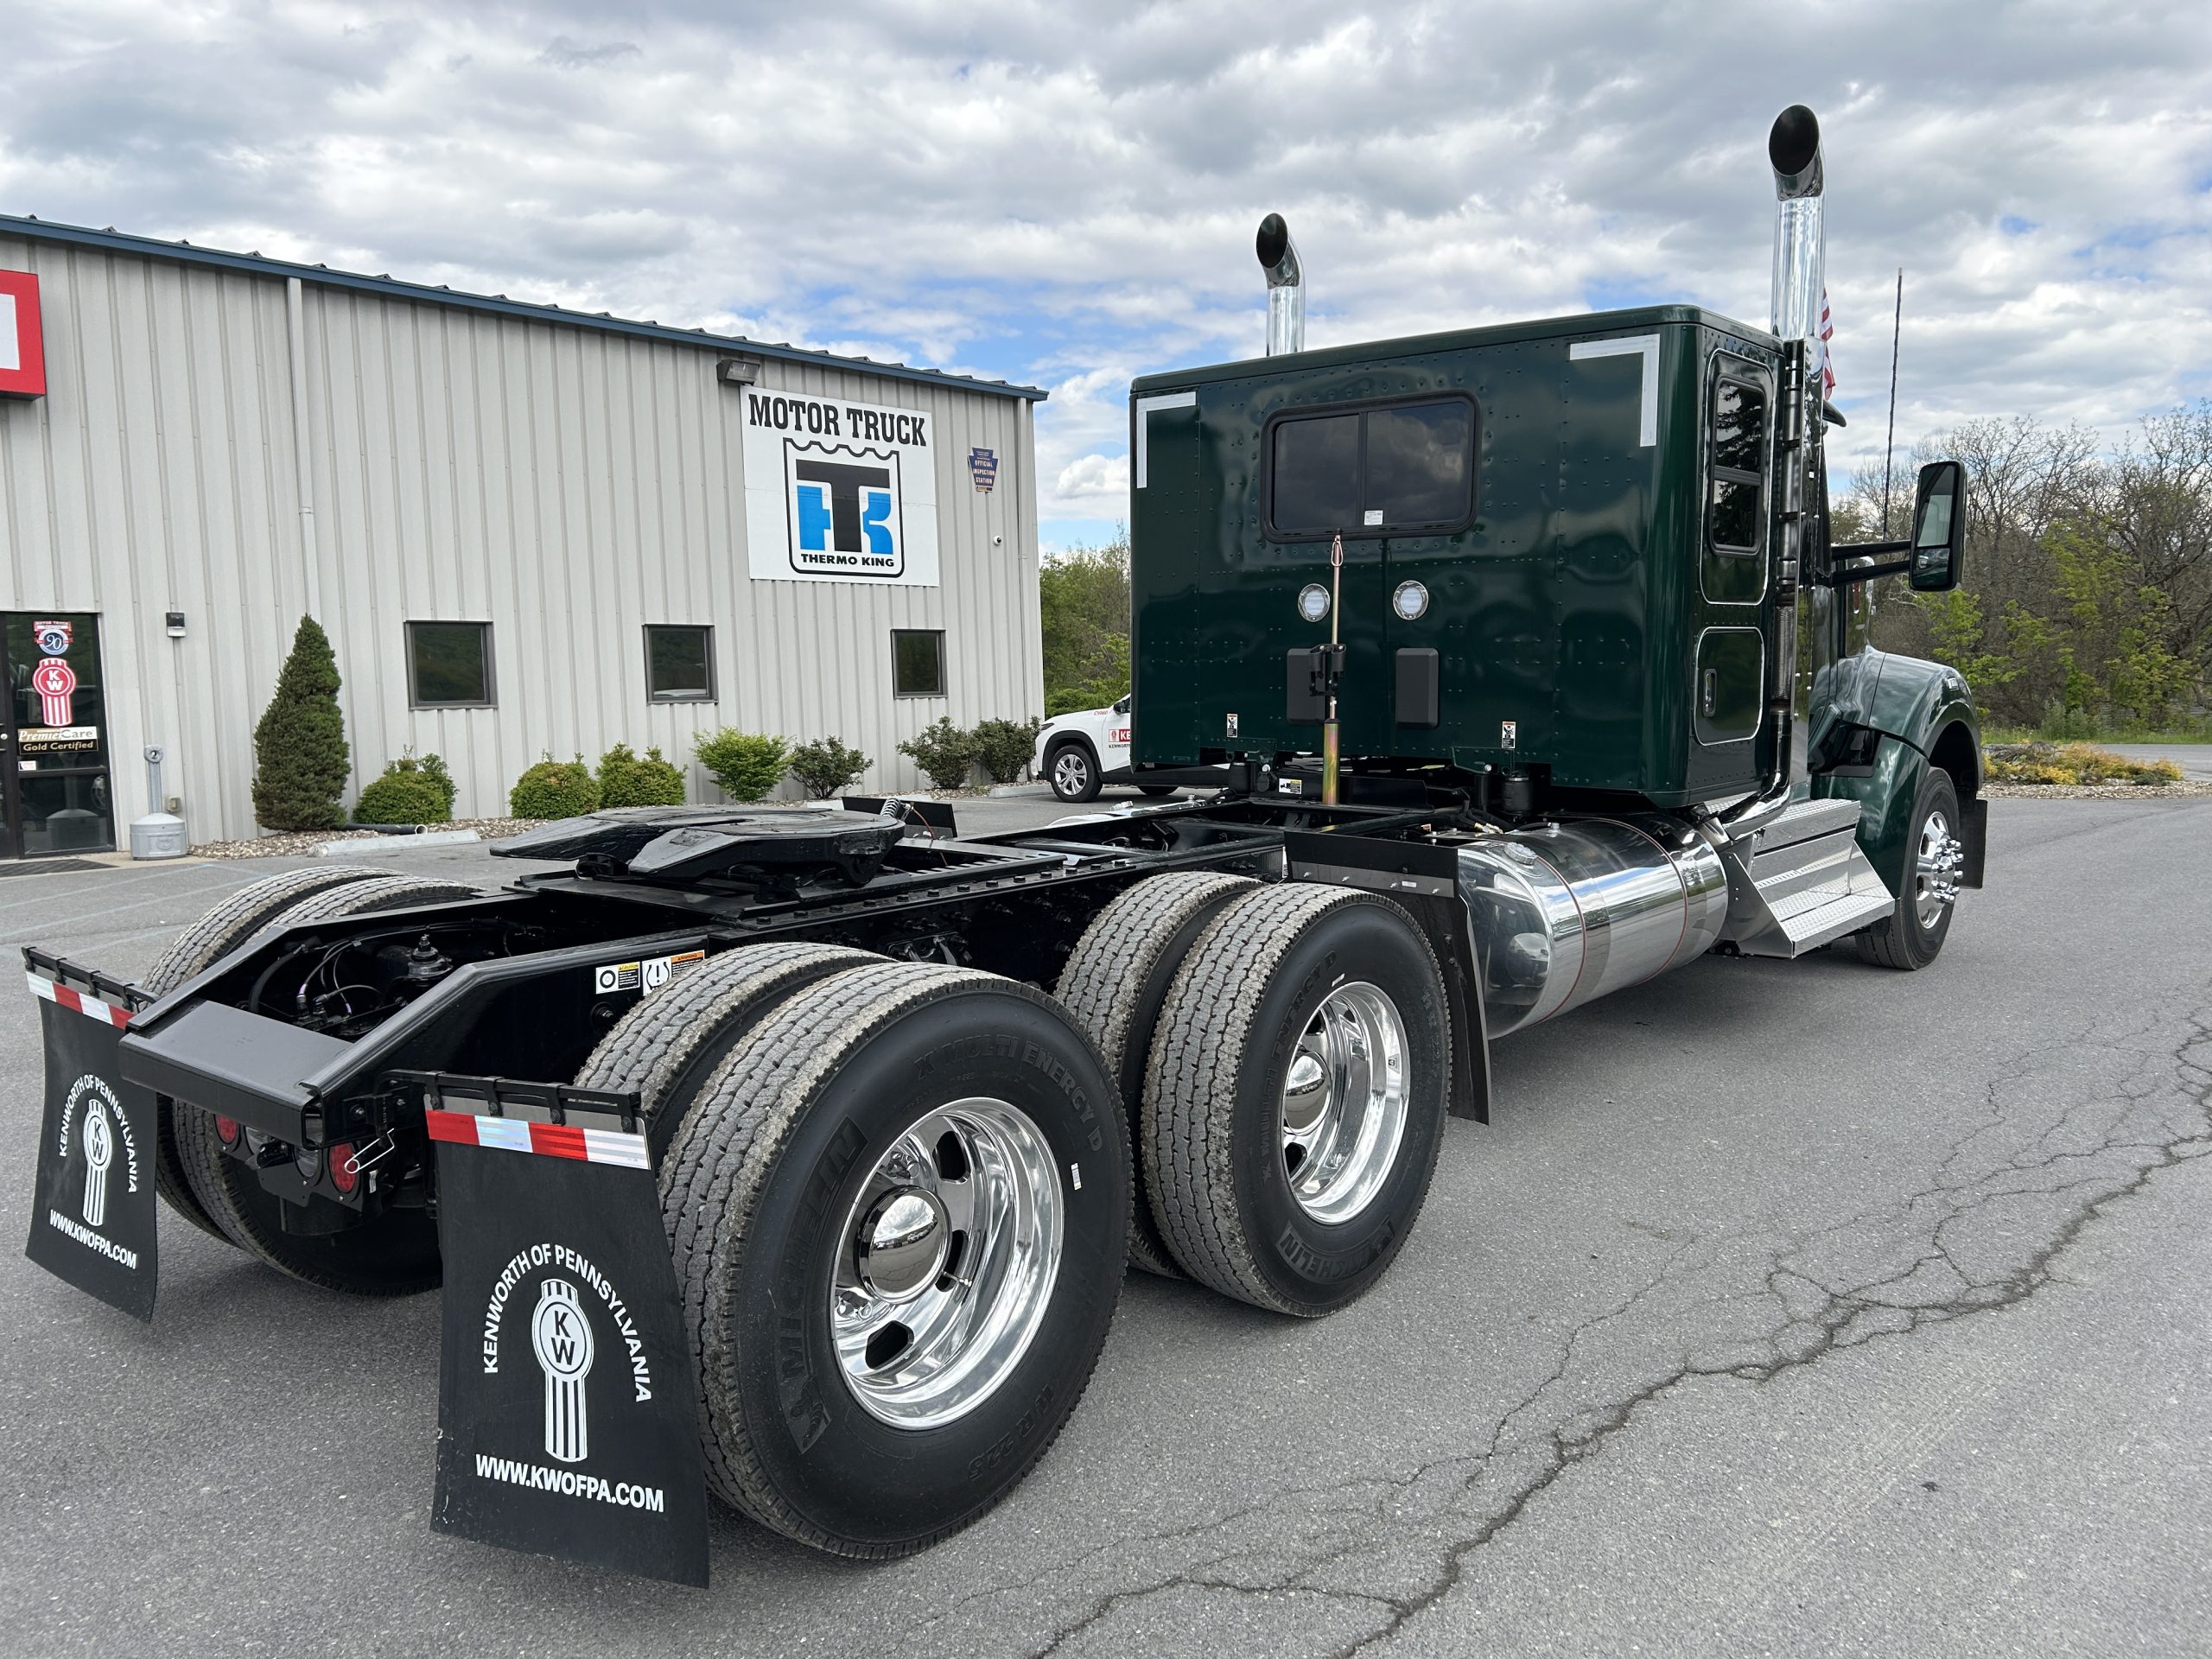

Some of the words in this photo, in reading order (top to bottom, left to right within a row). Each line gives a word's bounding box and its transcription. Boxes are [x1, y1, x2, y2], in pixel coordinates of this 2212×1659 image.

[748, 393, 841, 436] MOTOR
[846, 407, 927, 447] TRUCK
[800, 553, 858, 566] THERMO
[861, 556, 895, 568] KING
[45, 634, 62, 650] 90
[23, 743, 47, 752] Gold
[50, 741, 93, 751] Certified
[1022, 1040, 1095, 1123] ENERGY
[60, 1077, 85, 1158] KENWORTH
[84, 1074, 95, 1090] OF
[95, 1077, 137, 1193] PENNSYLVANIA
[49, 1209, 137, 1270] WWW.KWOFPA.COM
[483, 1250, 531, 1375] KENWORTH
[531, 1243, 553, 1268] OF
[554, 1243, 652, 1403] PENNSYLVANIA
[554, 1309, 569, 1338] K
[550, 1337, 575, 1367] W
[475, 1453, 664, 1513] WWW.KWOFPA.COM
